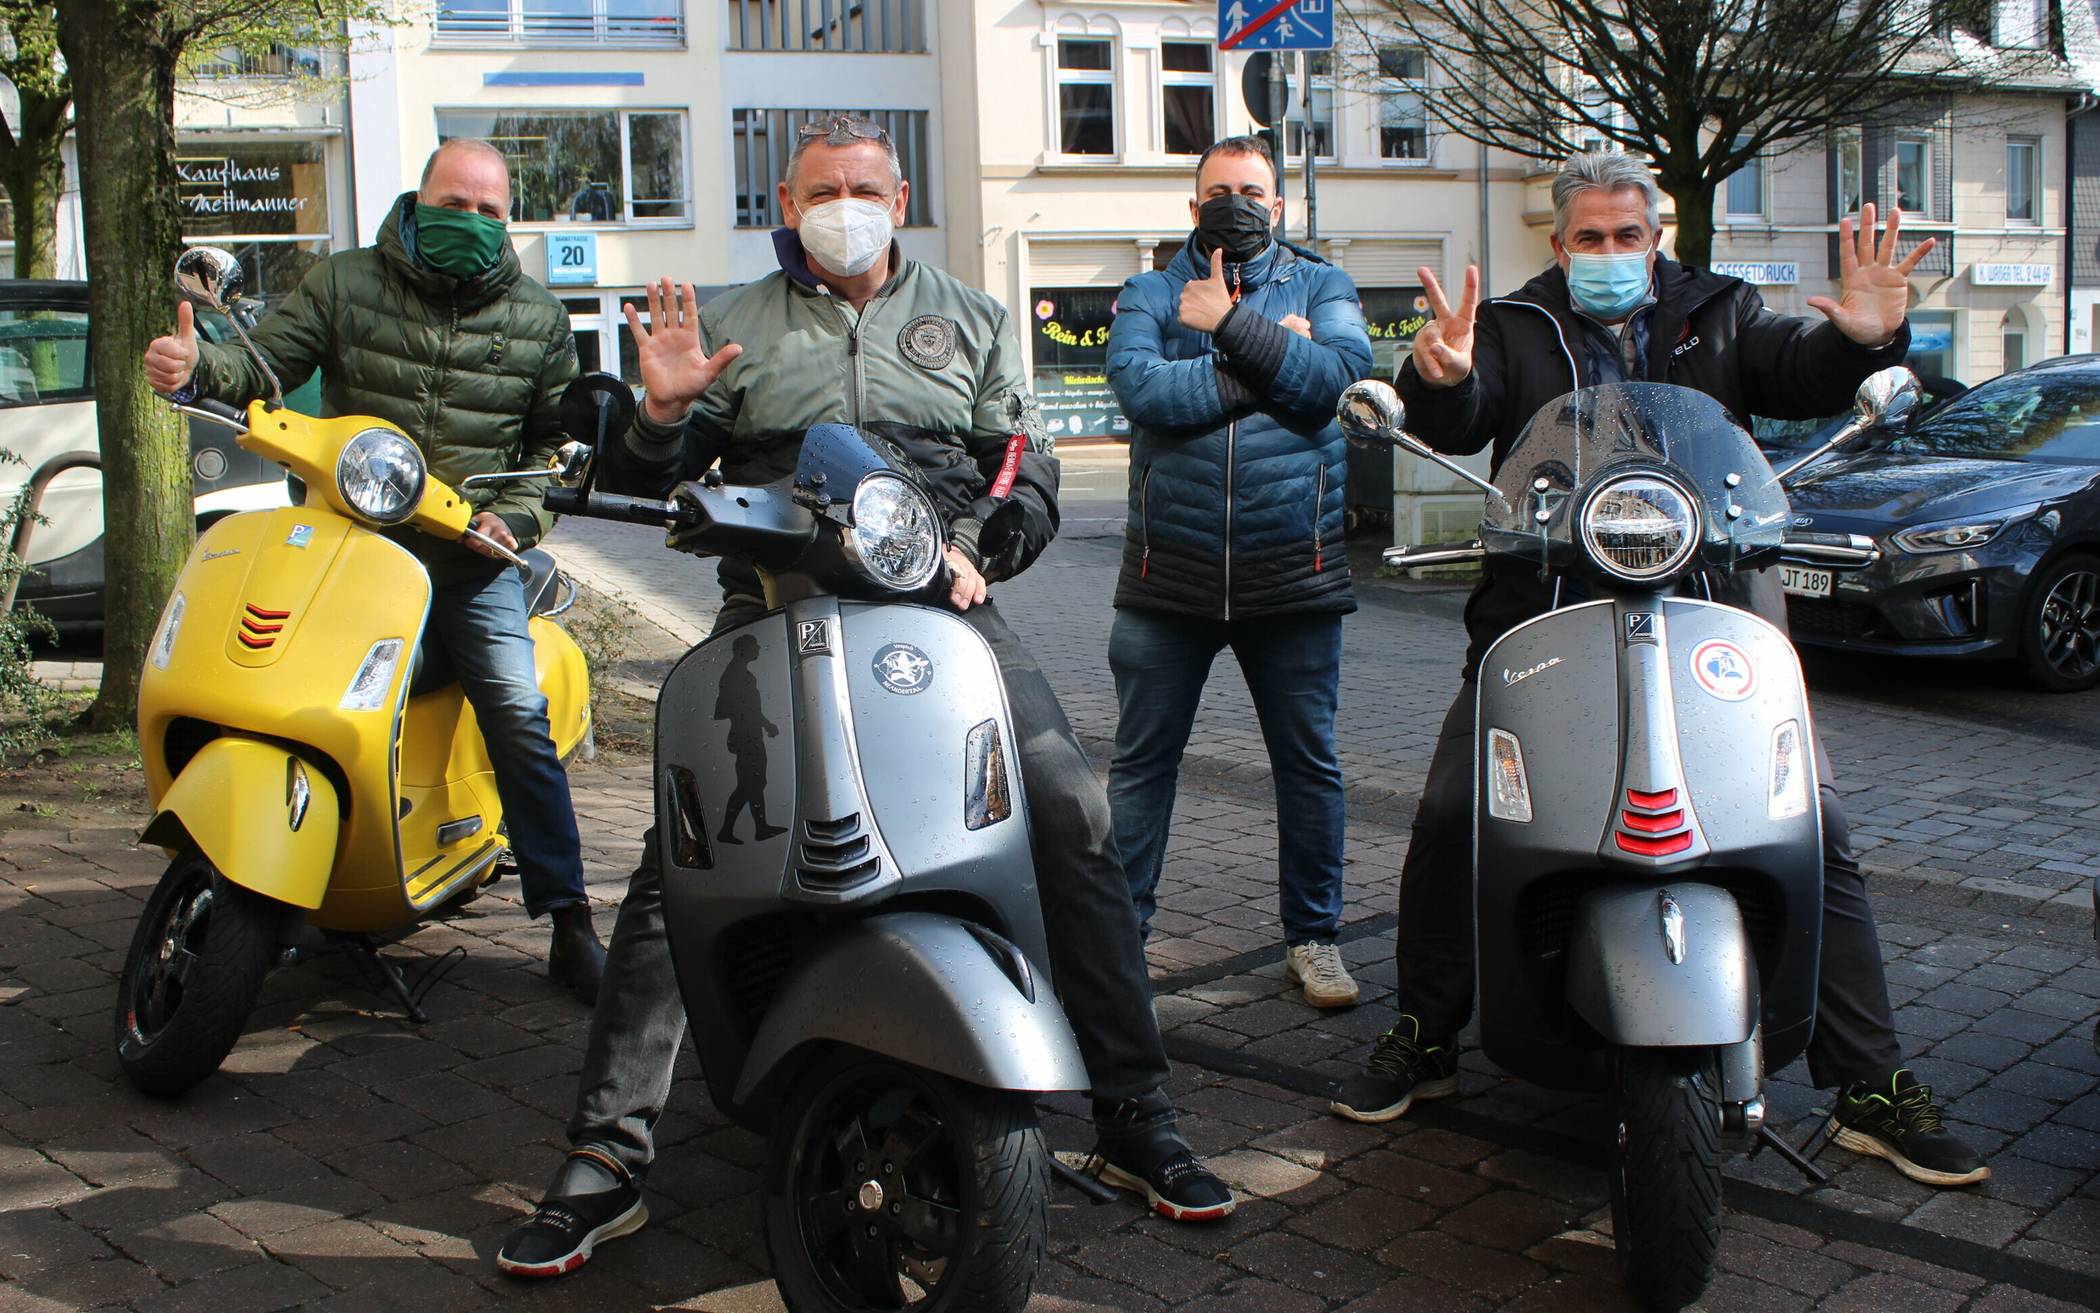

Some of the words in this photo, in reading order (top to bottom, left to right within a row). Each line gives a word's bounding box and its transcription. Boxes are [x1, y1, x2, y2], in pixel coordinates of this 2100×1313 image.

[176, 159, 280, 188] Kaufhaus
[190, 190, 308, 213] Mettmanner
[561, 245, 584, 266] 20
[1042, 321, 1077, 346] Rein
[1080, 329, 1093, 347] &
[1384, 322, 1396, 338] &
[1399, 315, 1425, 337] Fein
[1671, 336, 1700, 358] ELD
[290, 525, 305, 538] P
[1782, 569, 1800, 588] JT
[1802, 572, 1829, 592] 189
[801, 623, 815, 640] P
[1629, 614, 1641, 628] P
[1502, 656, 1566, 689] Vespa
